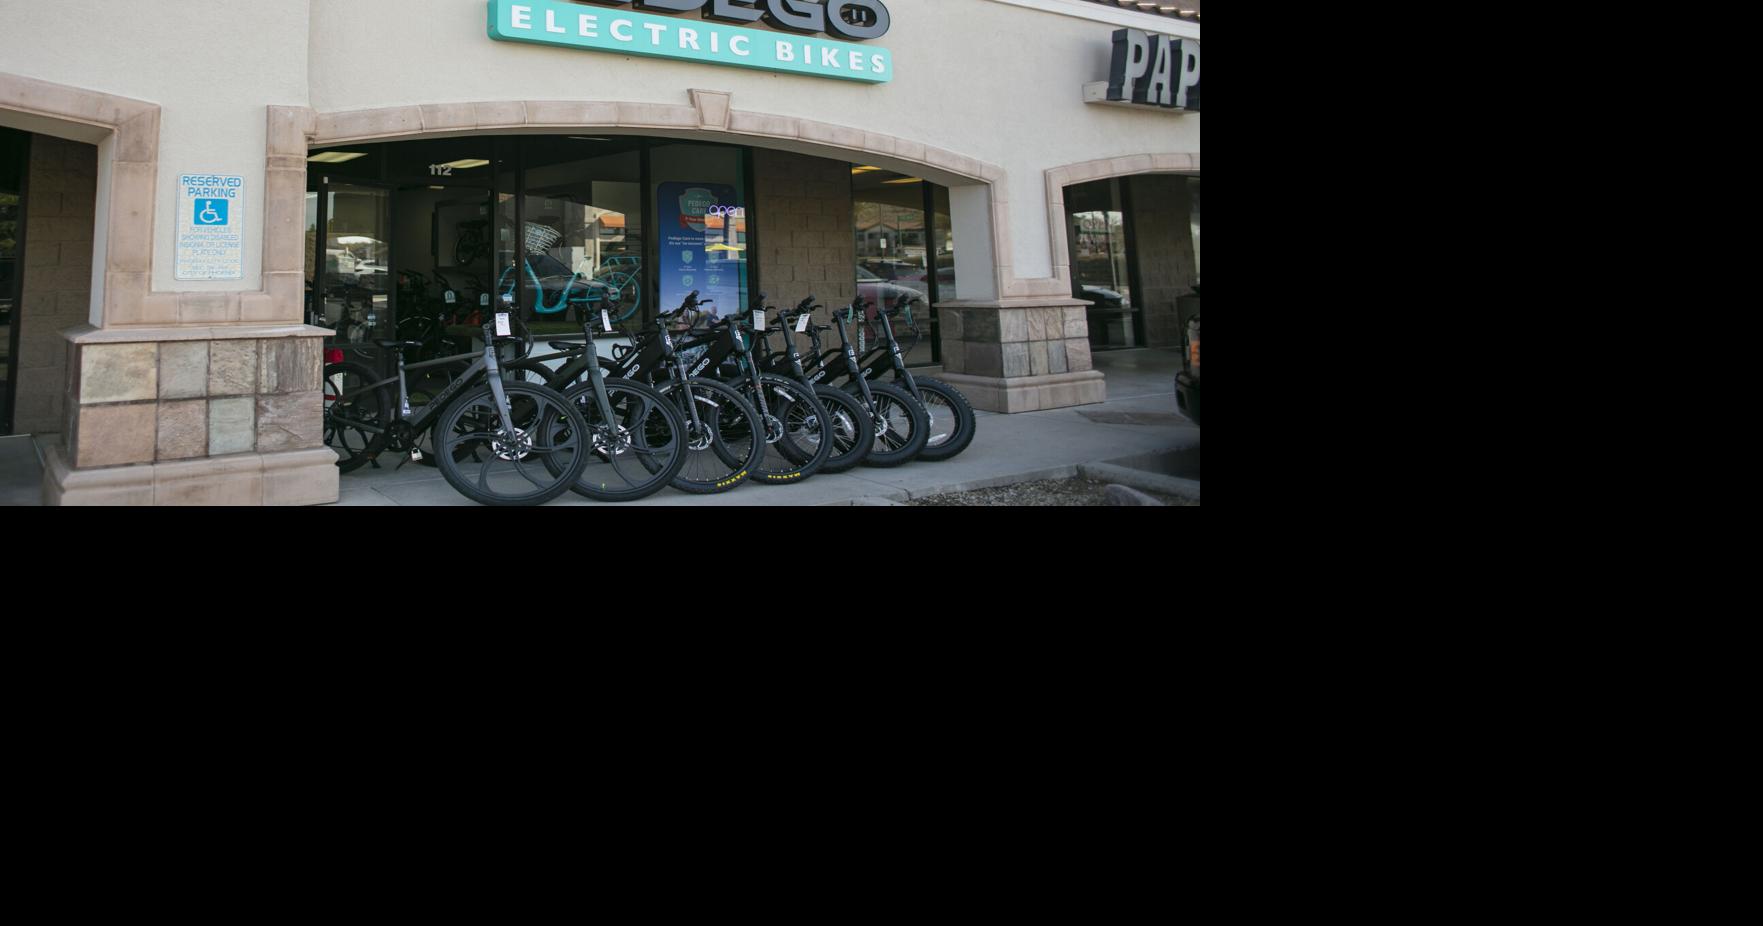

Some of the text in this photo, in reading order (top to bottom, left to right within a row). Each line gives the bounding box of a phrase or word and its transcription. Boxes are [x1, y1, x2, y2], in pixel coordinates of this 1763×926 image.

[510, 5, 886, 74] ELECTRIC BIKES
[1115, 28, 1200, 107] PAP
[429, 164, 451, 176] 112
[182, 175, 241, 187] RESERVED
[187, 187, 236, 198] PARKING
